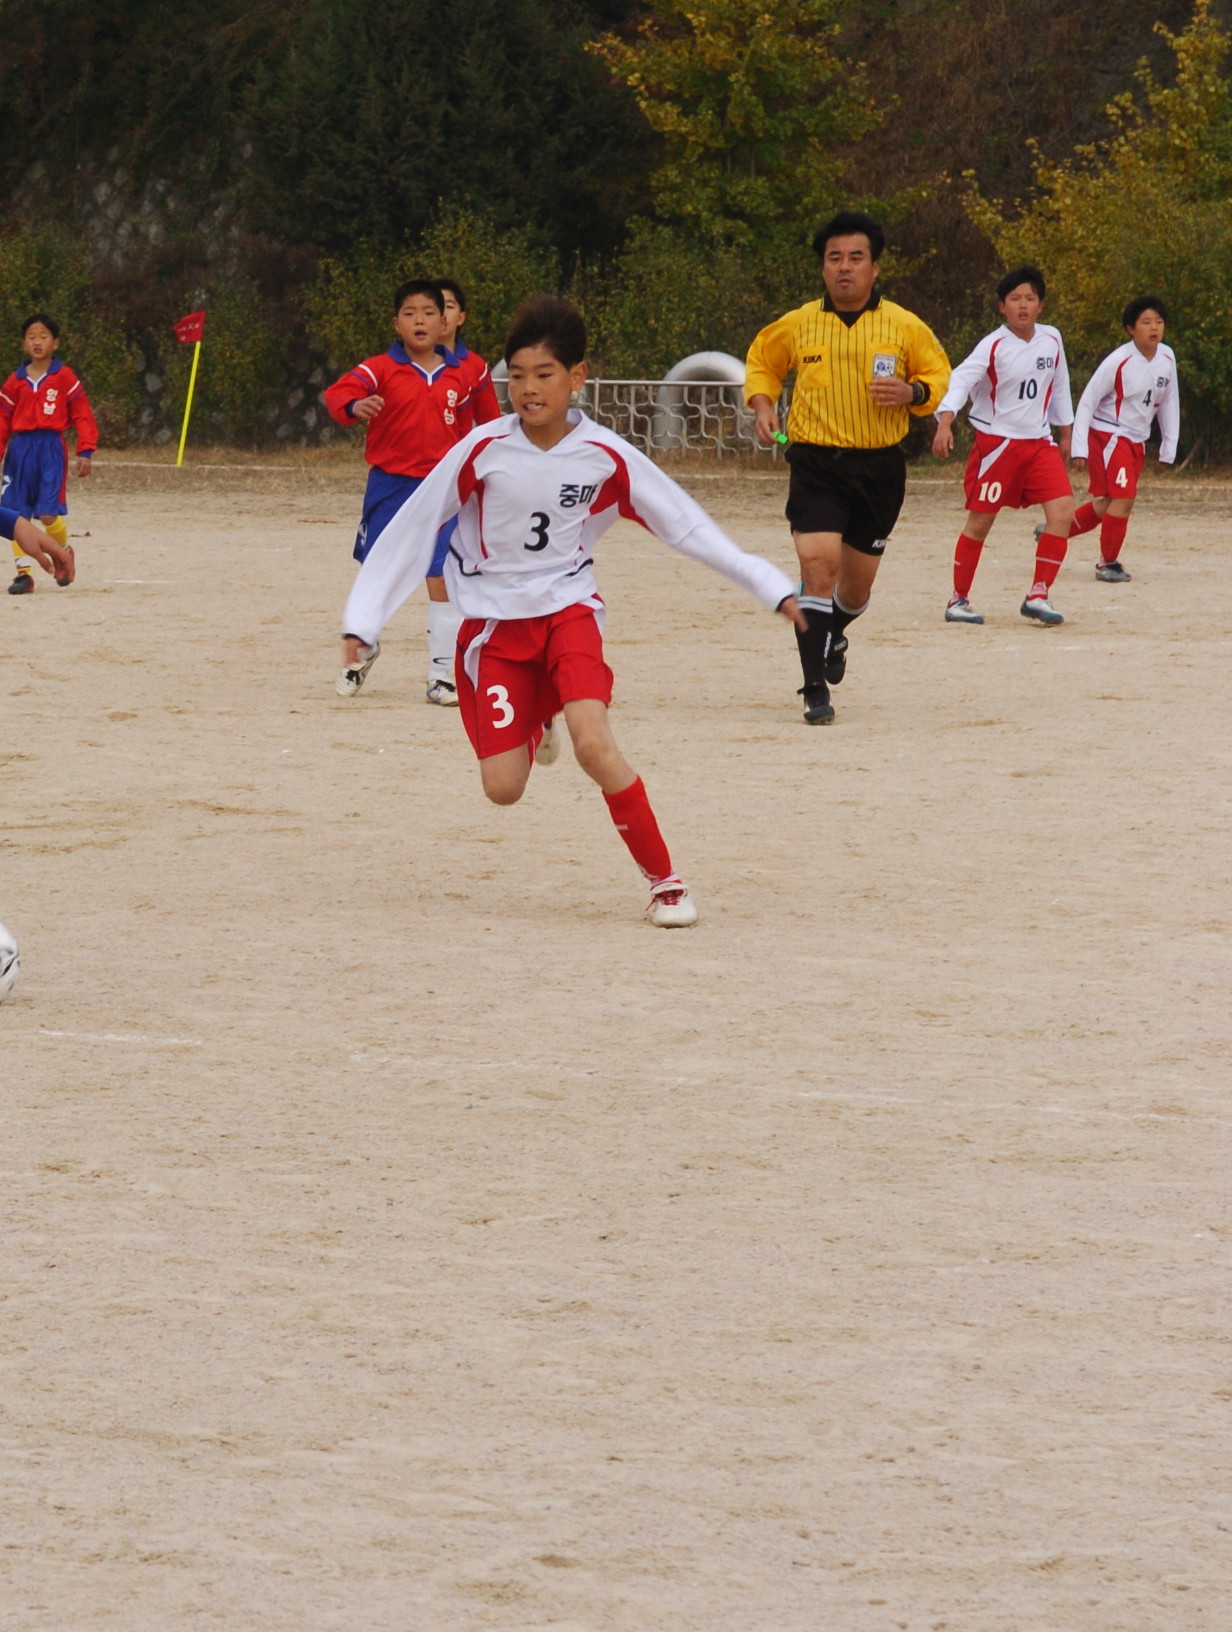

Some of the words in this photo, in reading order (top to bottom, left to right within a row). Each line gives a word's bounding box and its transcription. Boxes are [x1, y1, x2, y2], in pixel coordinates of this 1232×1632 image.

[1018, 378, 1038, 400] 10
[1142, 389, 1152, 407] 4
[1115, 467, 1129, 488] 4
[559, 484, 598, 508] 중마
[978, 481, 1002, 504] 10
[524, 511, 551, 552] 3
[486, 684, 515, 729] 3
